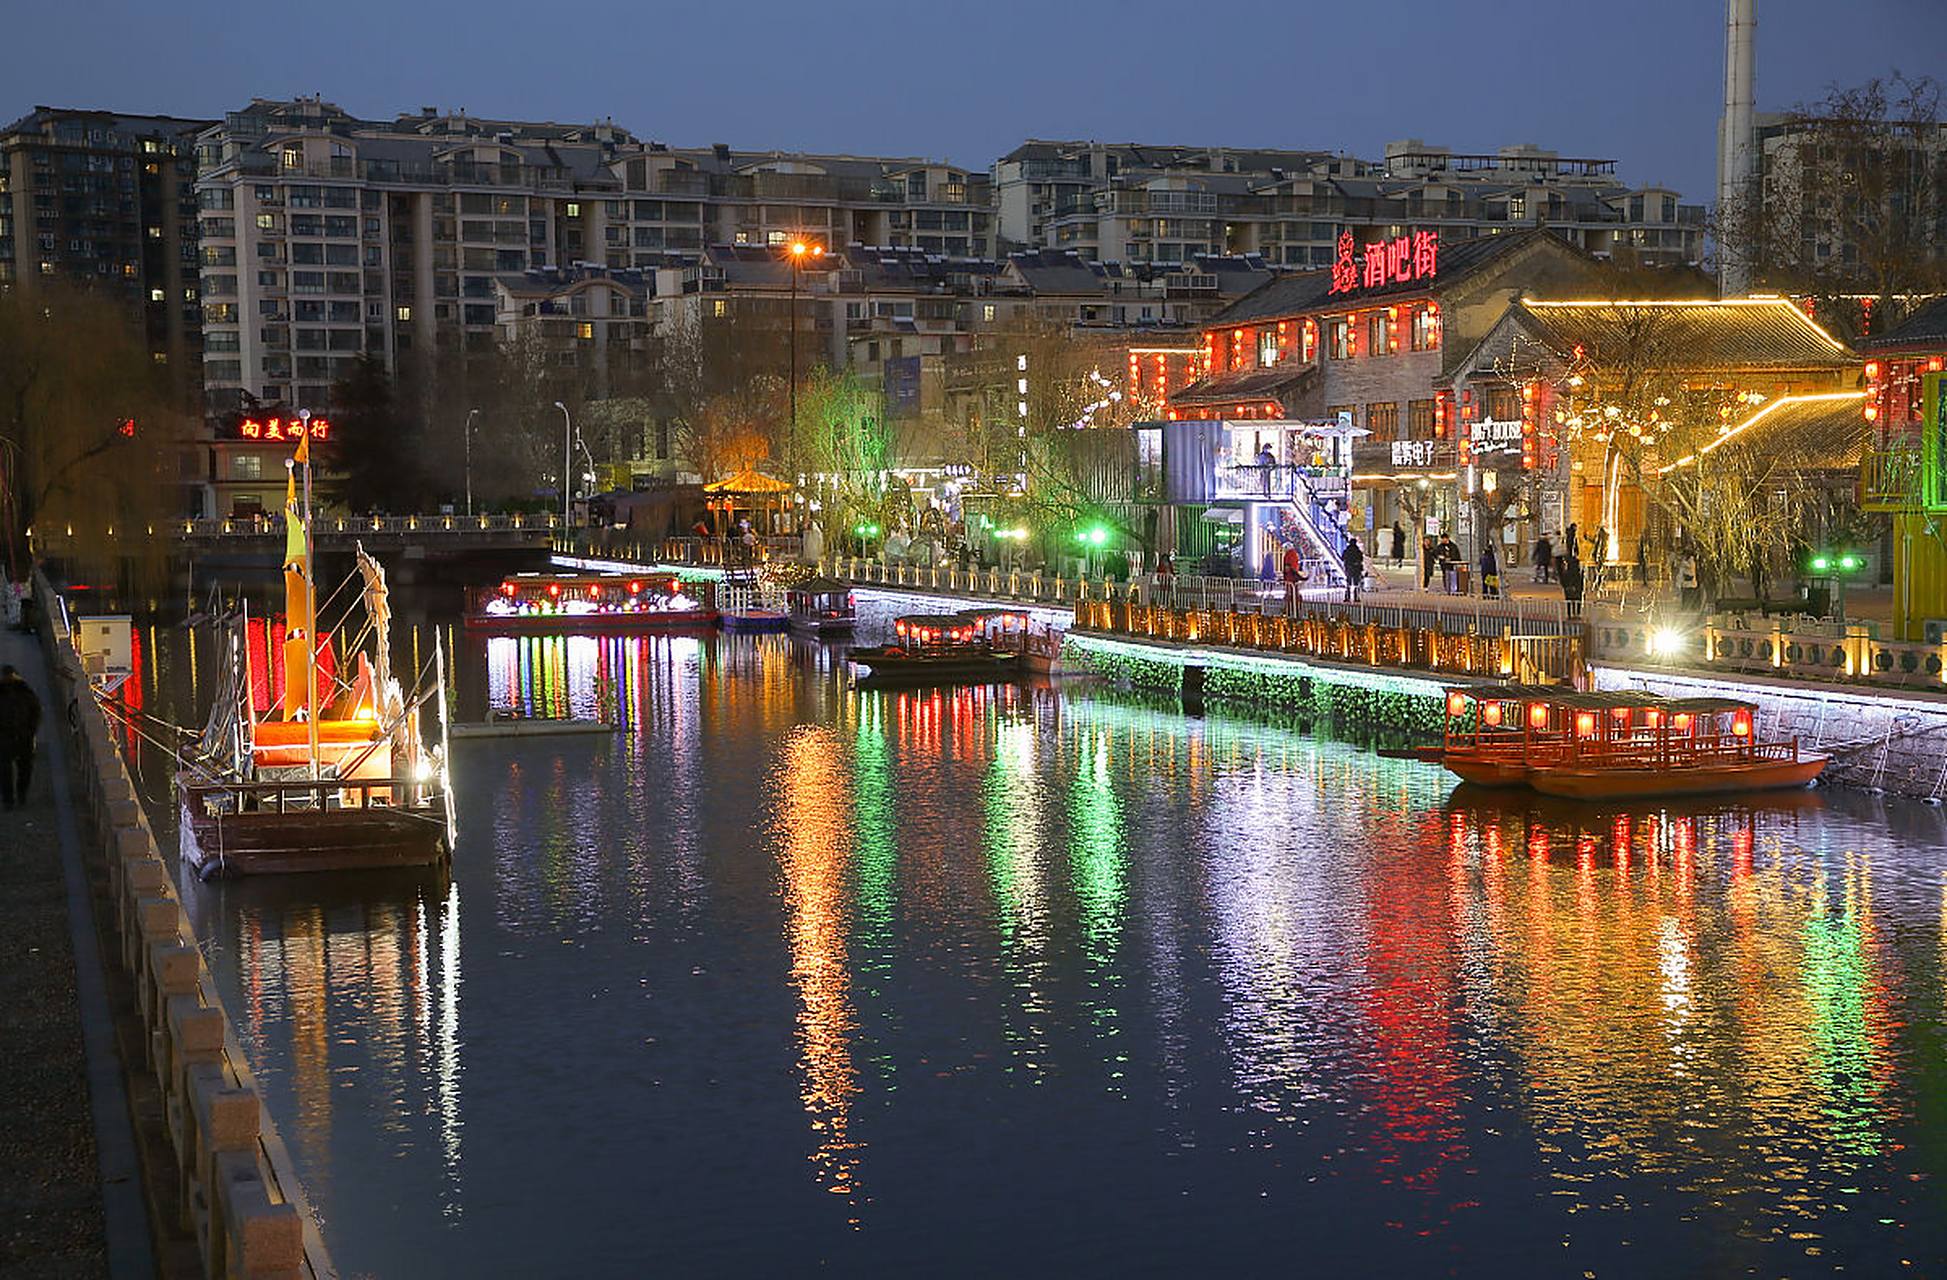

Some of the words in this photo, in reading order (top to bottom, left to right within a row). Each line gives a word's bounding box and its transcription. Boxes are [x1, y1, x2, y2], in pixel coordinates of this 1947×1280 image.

[1363, 231, 1438, 288] 酒吧街
[241, 418, 329, 440] 向美而行
